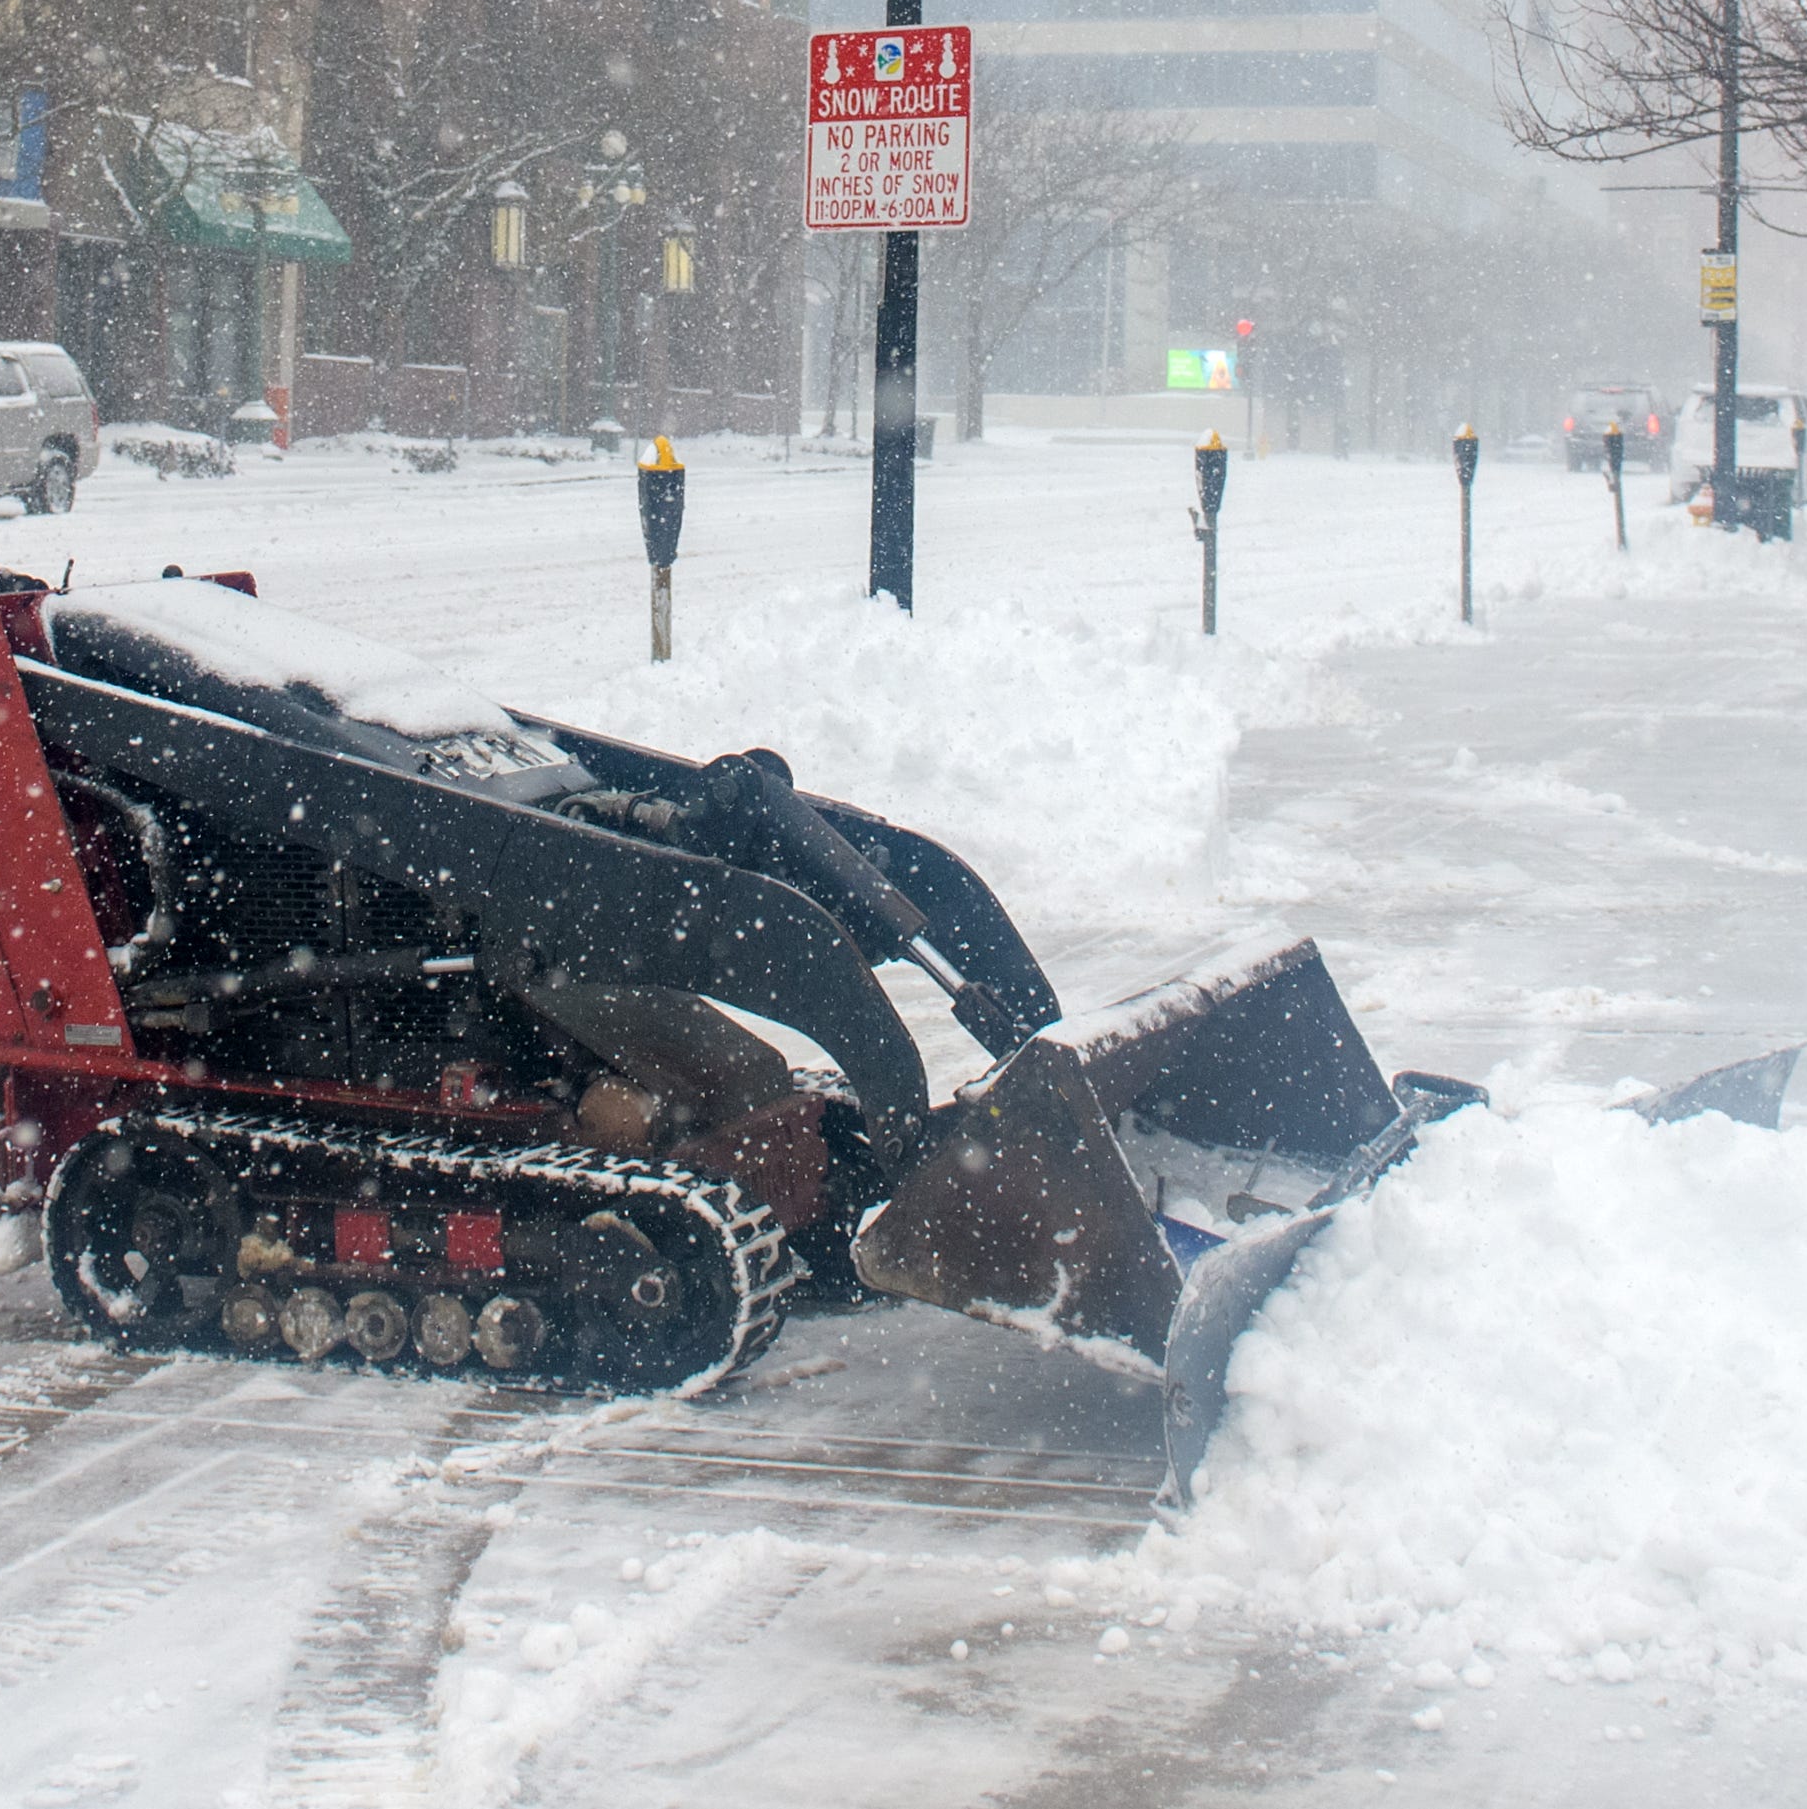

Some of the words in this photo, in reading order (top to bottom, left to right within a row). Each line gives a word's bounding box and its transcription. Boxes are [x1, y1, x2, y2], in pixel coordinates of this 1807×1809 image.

[818, 88, 878, 117] SNOW
[890, 84, 962, 113] ROUTE
[827, 125, 854, 150] NO
[865, 121, 950, 149] PARKING
[840, 153, 850, 173] 2
[858, 152, 880, 172] OR
[890, 150, 934, 171] MORE
[815, 175, 874, 197] INCHES
[883, 174, 904, 195] OF
[912, 173, 960, 194] SNOW
